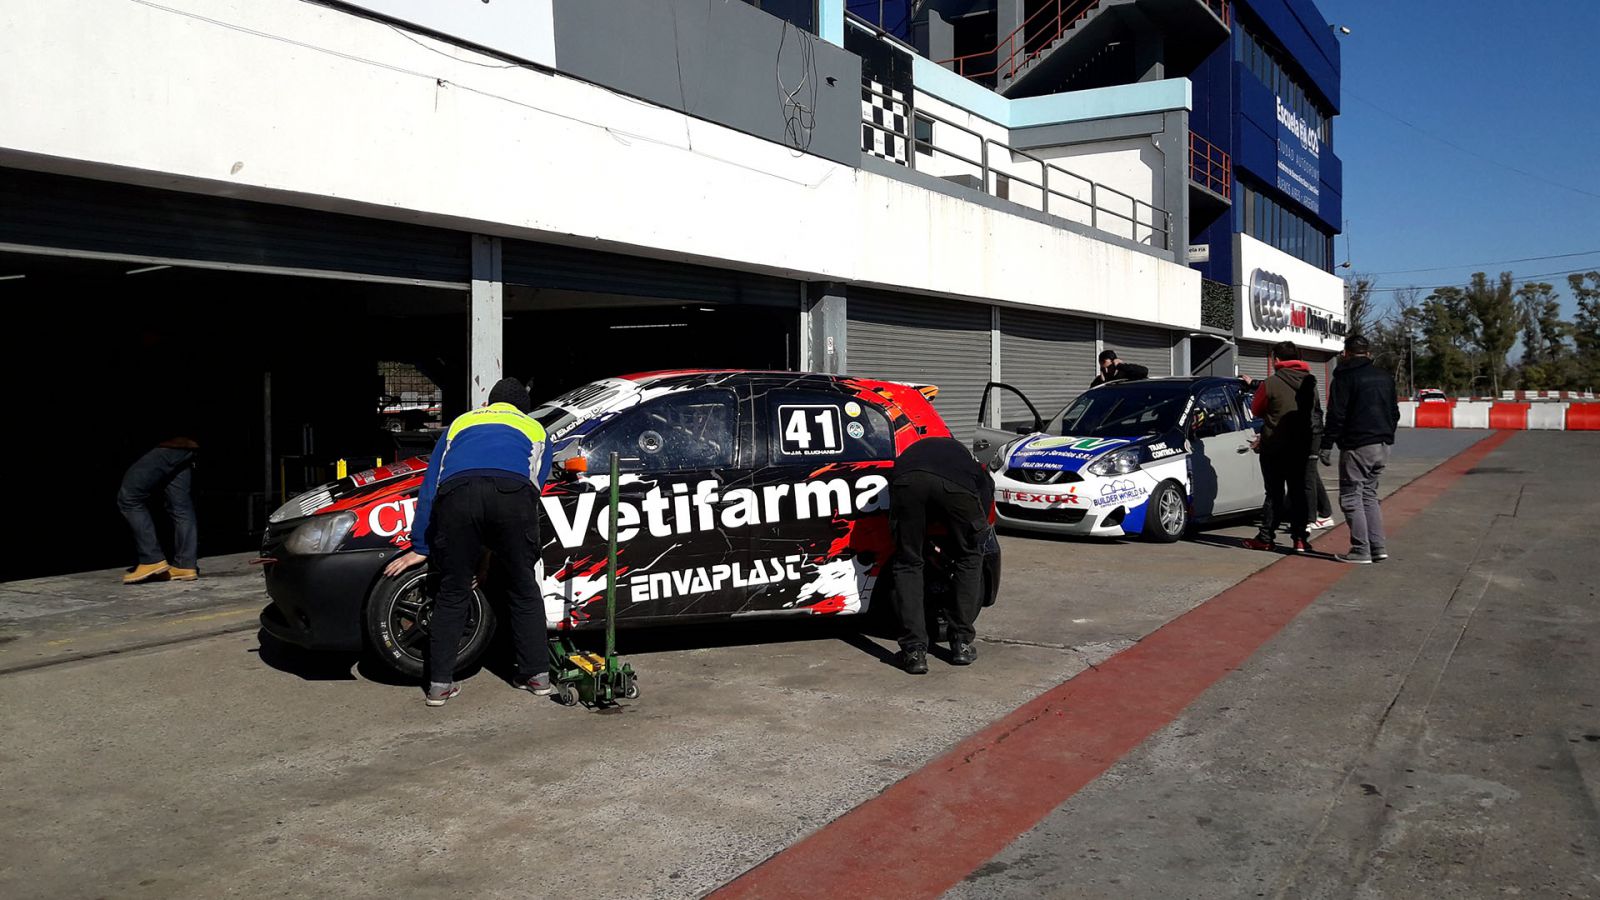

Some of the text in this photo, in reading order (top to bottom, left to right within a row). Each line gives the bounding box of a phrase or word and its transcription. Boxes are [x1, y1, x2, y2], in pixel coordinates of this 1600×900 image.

[1277, 95, 1300, 138] Escuela
[1290, 303, 1306, 328] Audi
[1307, 307, 1328, 339] Driving
[785, 410, 836, 448] 41
[1148, 441, 1167, 452] TRANS
[1152, 447, 1176, 459] CONTROL
[540, 475, 890, 549] Vetifarma
[1093, 494, 1119, 507] BUILDER
[1118, 489, 1139, 500] WORLD
[631, 554, 801, 603] ENVAPLAST
